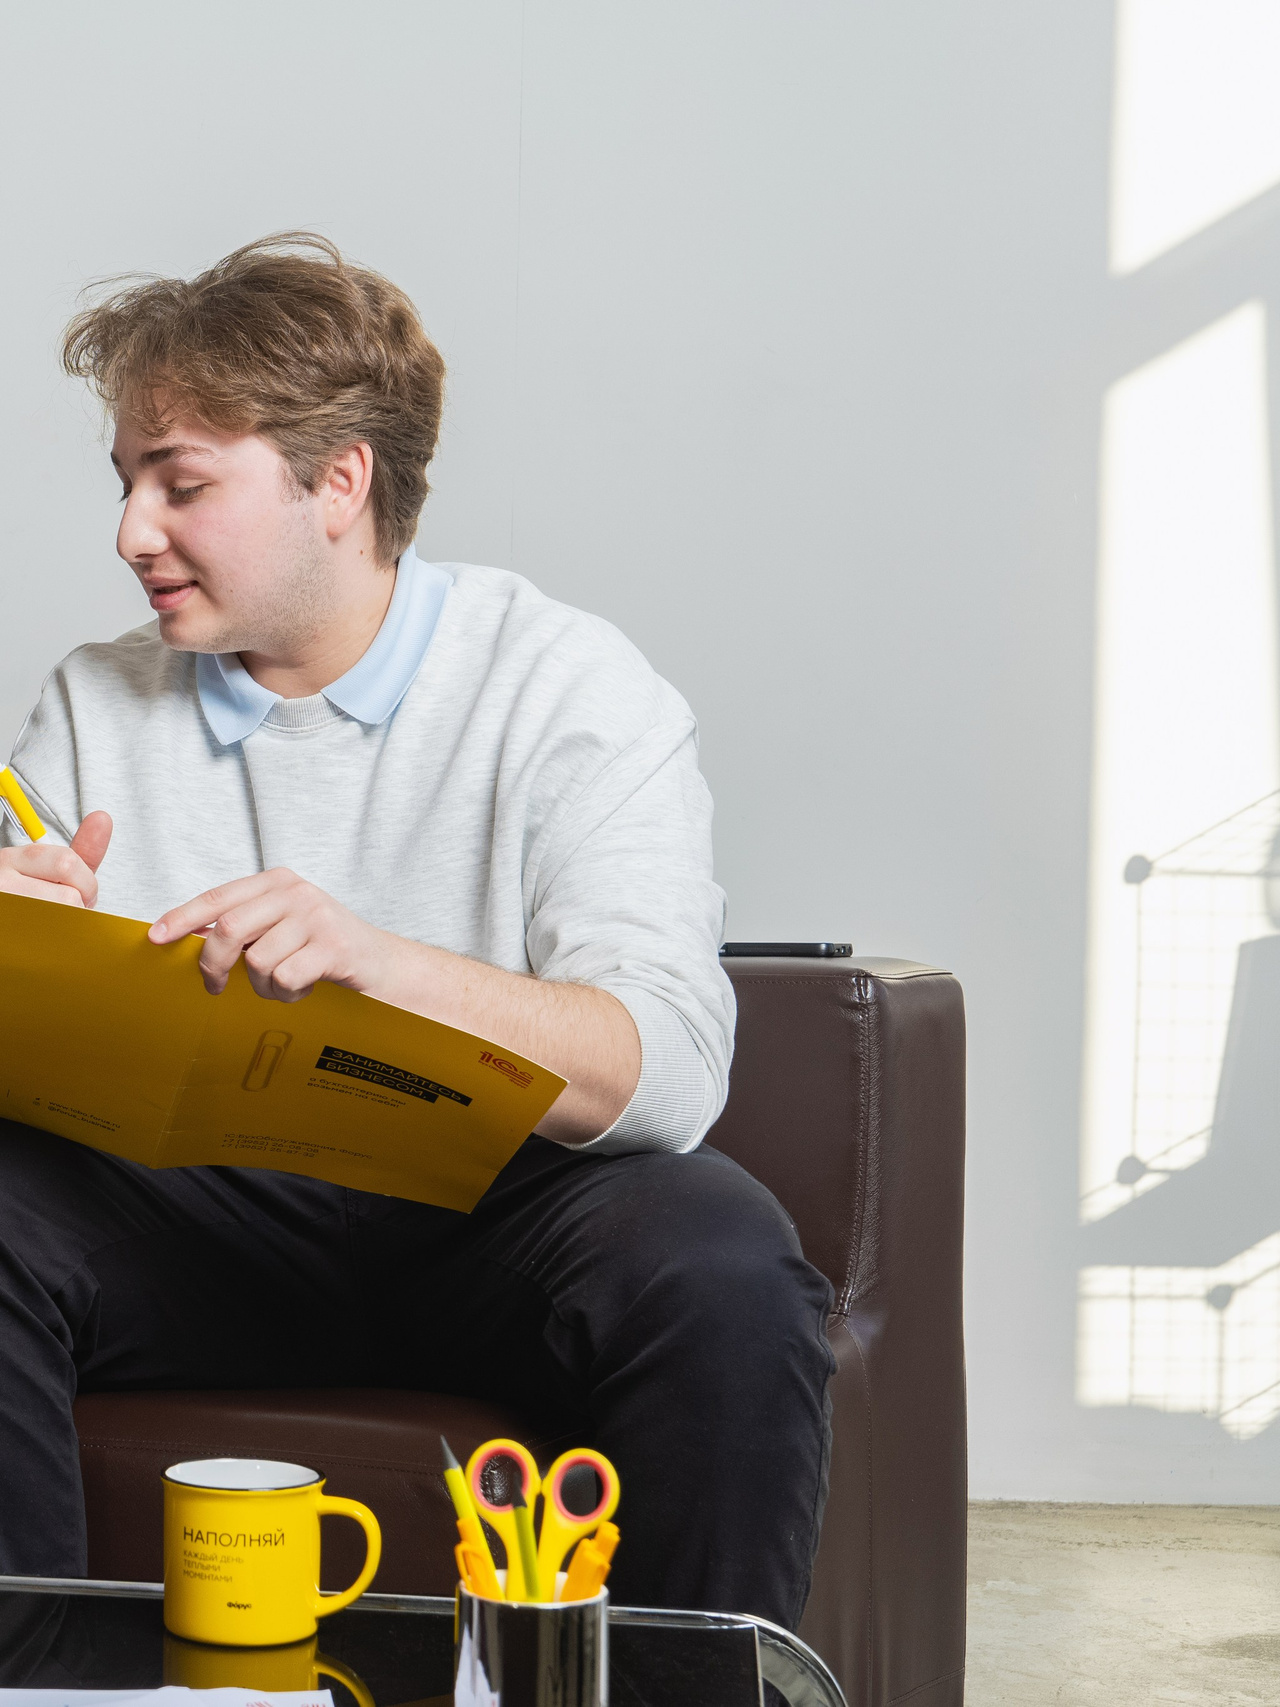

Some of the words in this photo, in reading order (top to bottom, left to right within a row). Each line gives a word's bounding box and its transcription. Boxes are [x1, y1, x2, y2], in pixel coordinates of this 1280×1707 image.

[325, 1062, 428, 1099] БИЗНЕСОМ,
[331, 1050, 462, 1101] ЗАНИМАЙТЕСЬ
[319, 1078, 389, 1101] бухгалтерию
[390, 1098, 407, 1106] мы
[183, 1526, 285, 1548] НАПОЛНЯЙ
